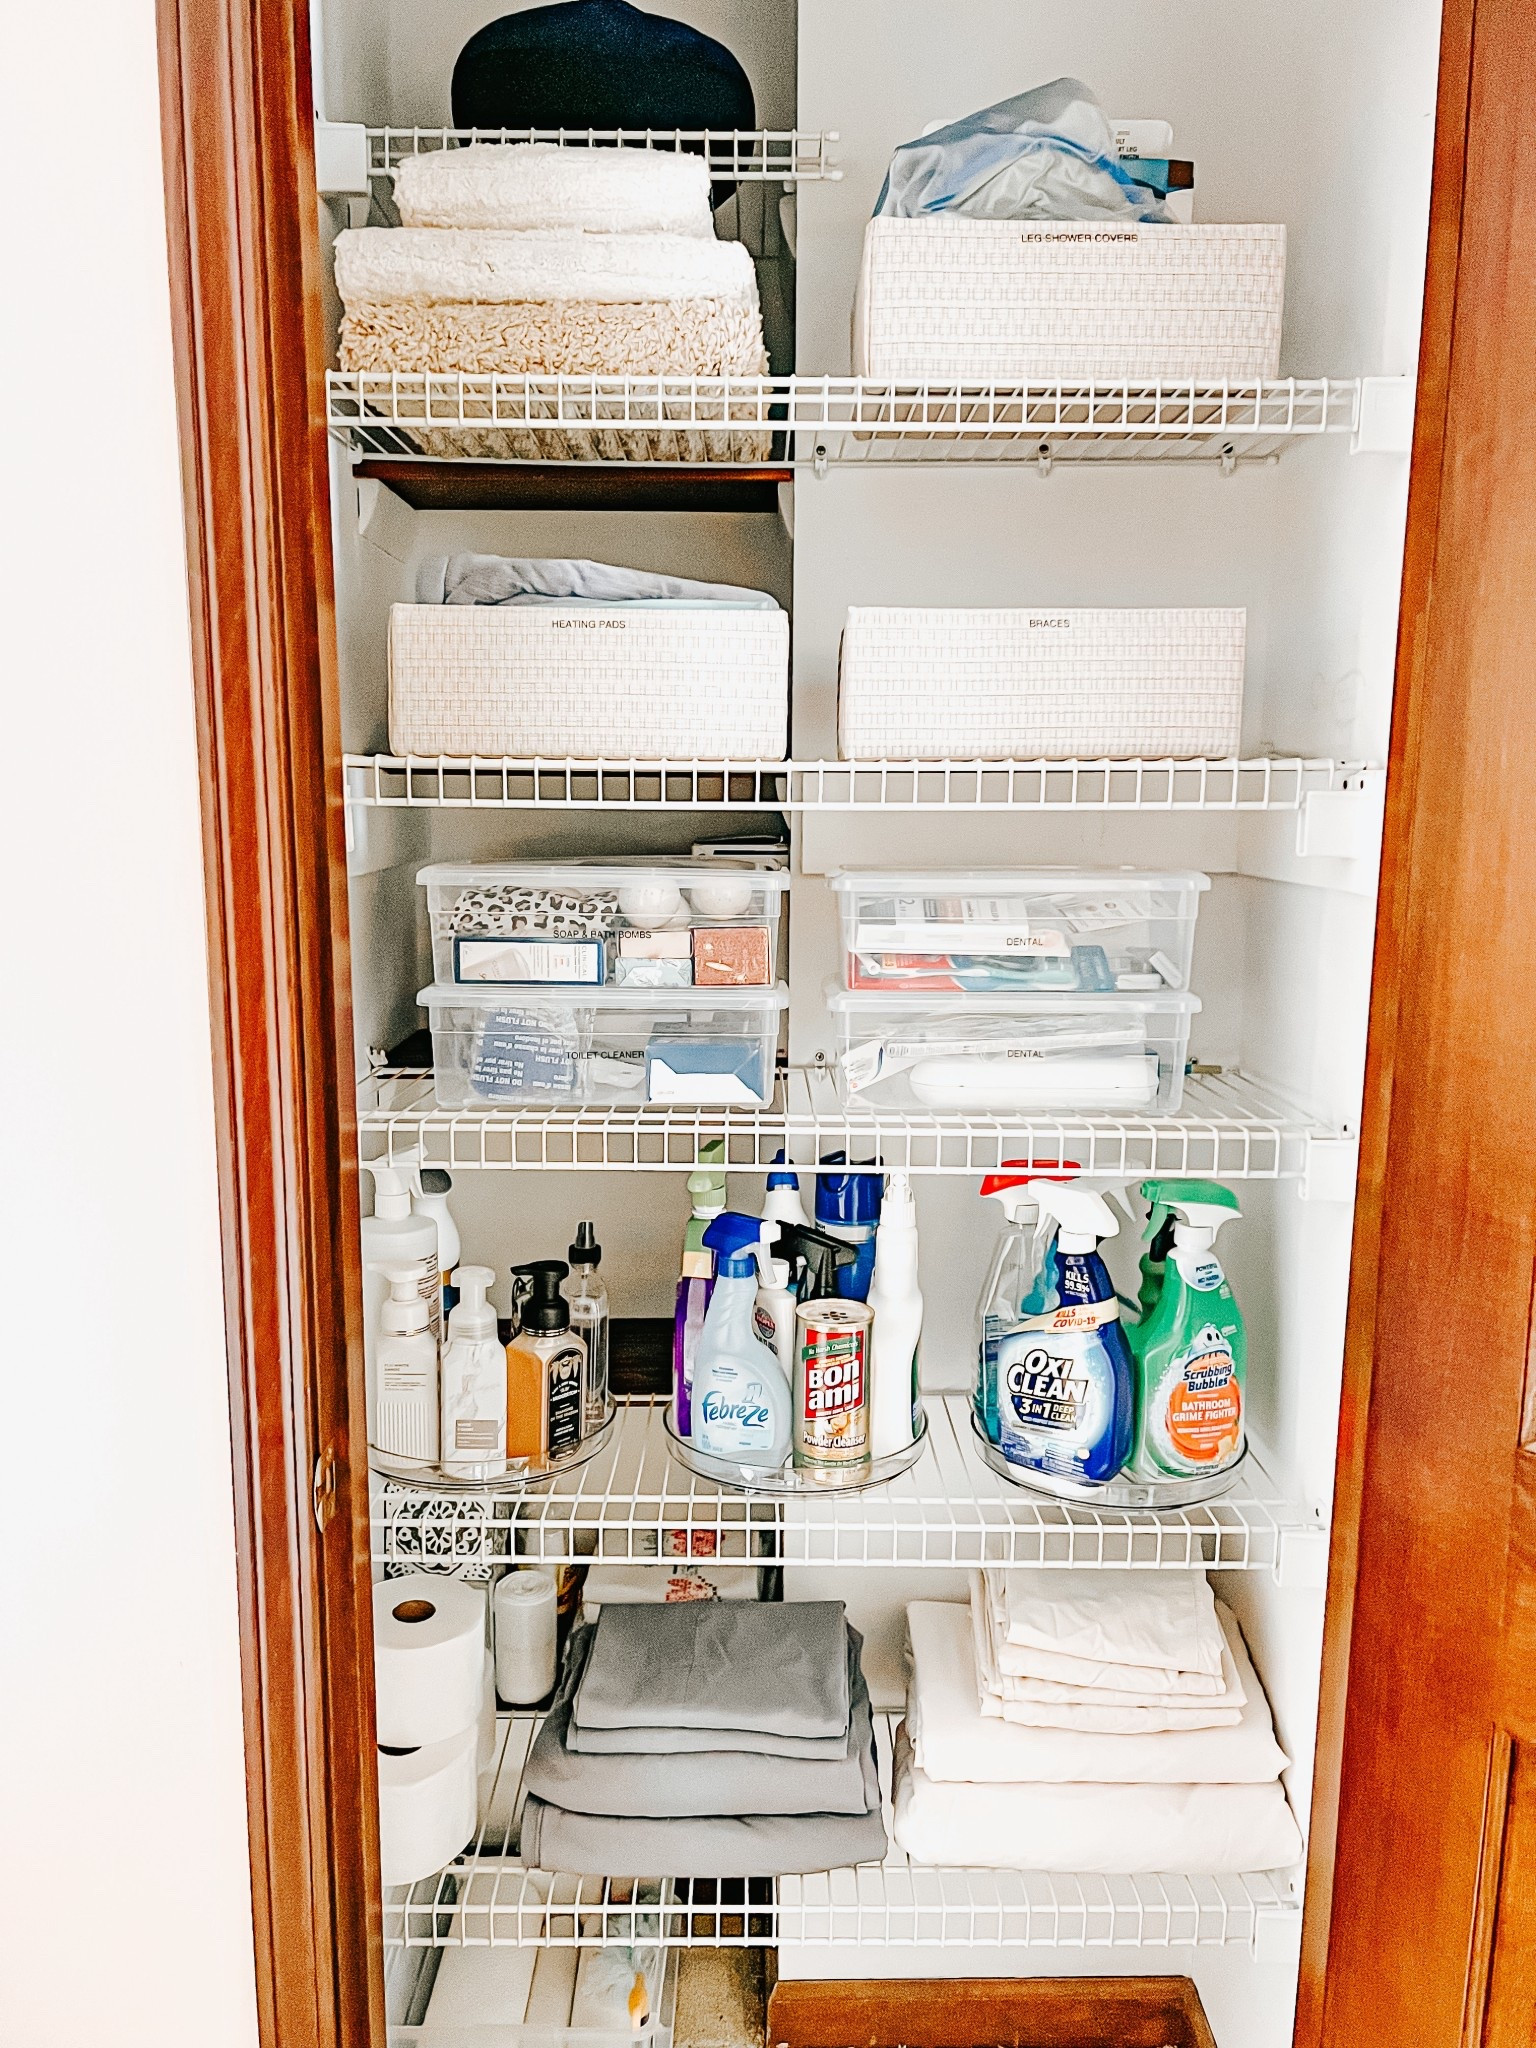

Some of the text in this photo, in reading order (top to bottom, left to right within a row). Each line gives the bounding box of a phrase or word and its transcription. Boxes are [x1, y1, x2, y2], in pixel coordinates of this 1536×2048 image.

[1021, 234, 1139, 243] LEG SHOWER COVERS
[551, 619, 626, 629] HEATING PADS
[1029, 619, 1070, 628] BRACES
[553, 930, 652, 939] SOAP & BATH BOMBS
[1006, 937, 1044, 946] DENTAL
[496, 1016, 519, 1025] FLUSH
[520, 1019, 536, 1027] NOT
[535, 1055, 559, 1064] FLUSH
[566, 1050, 645, 1060] TOILET CLEANER
[1007, 1049, 1045, 1059] DENTAL
[471, 1074, 493, 1082] FLUSH
[1065, 1270, 1089, 1283] KILLS
[1064, 1280, 1090, 1293] 99.9%
[1055, 1308, 1076, 1318] KILLS
[1053, 1316, 1096, 1328] COVID-19
[1024, 1348, 1074, 1380] OXI
[808, 1359, 860, 1389] Bon
[1183, 1364, 1233, 1381] Scrubbing
[1007, 1363, 1088, 1404] CLEAN
[1188, 1376, 1228, 1392] Bubbles
[808, 1380, 860, 1410] ami
[1019, 1397, 1075, 1419] 3 IN 1 DEEP
[1181, 1398, 1231, 1411] BATHROOM
[1051, 1411, 1077, 1422] CLEAN
[1172, 1407, 1237, 1422] GRIME FIGHTER
[803, 1430, 866, 1448] Powder Cleanser
